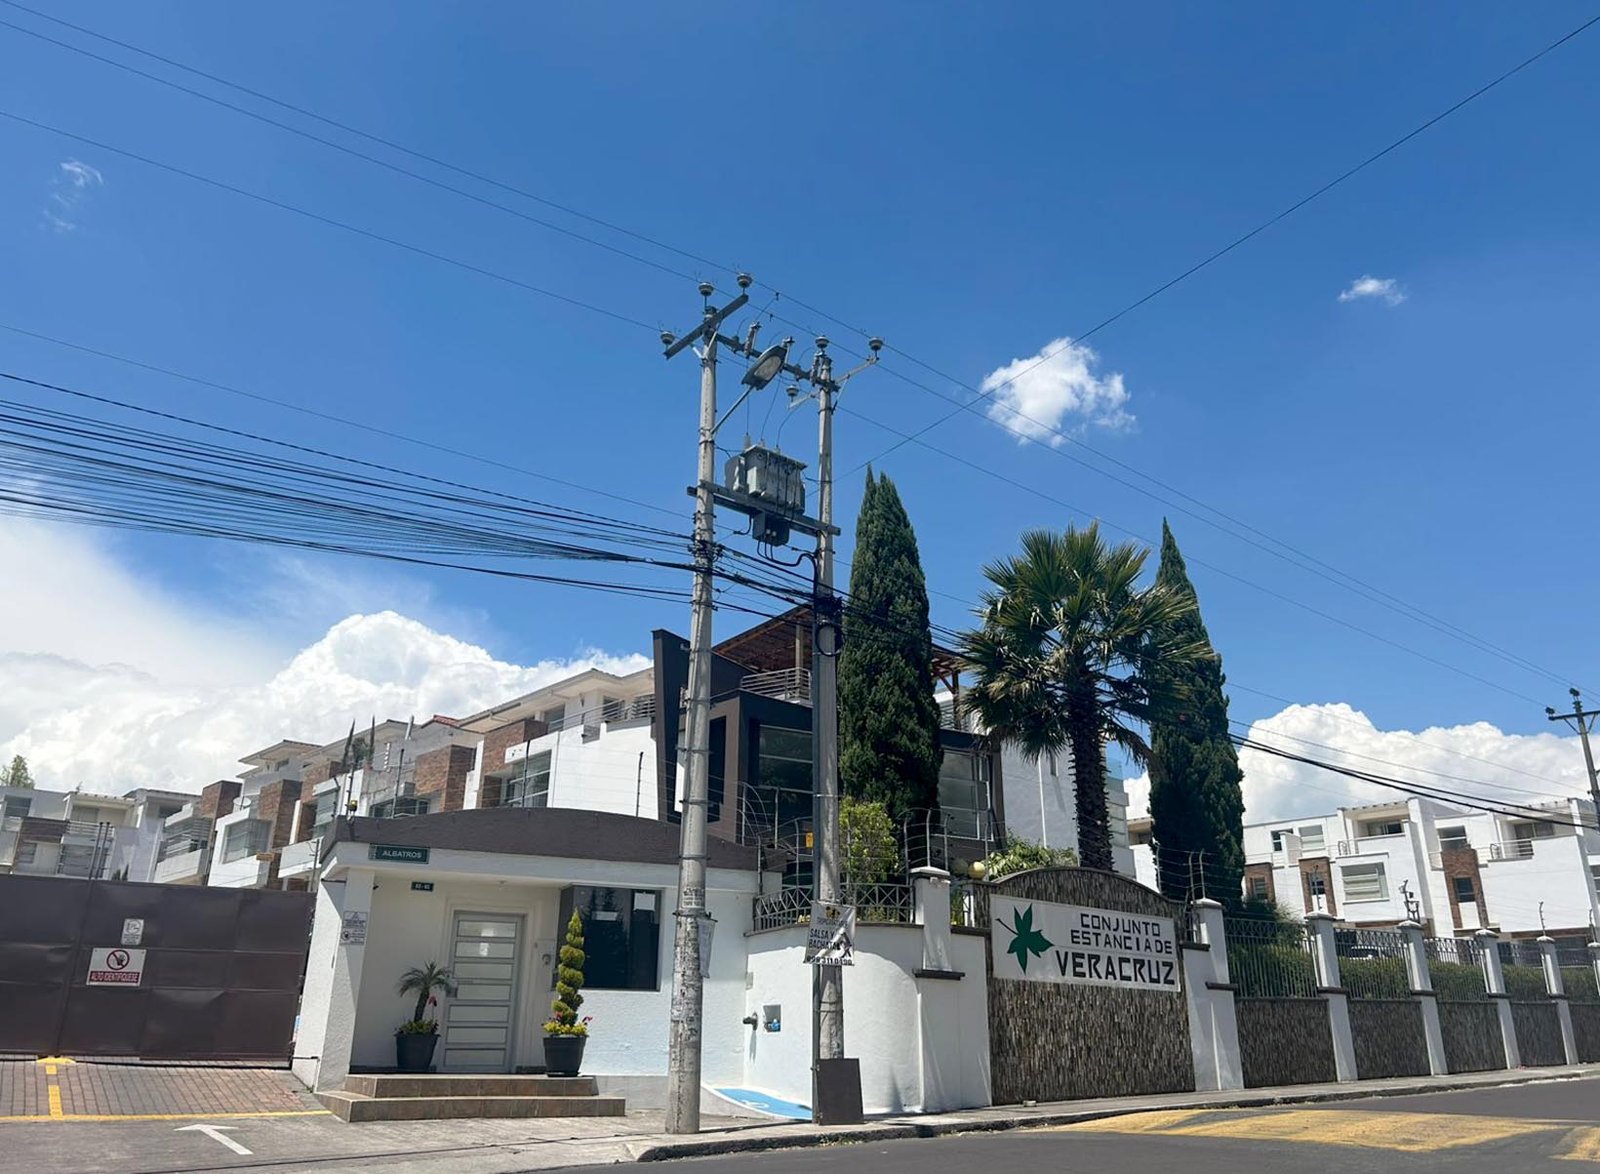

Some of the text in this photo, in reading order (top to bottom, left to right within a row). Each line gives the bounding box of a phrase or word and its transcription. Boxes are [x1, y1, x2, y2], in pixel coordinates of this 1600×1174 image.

[382, 850, 422, 859] ALBATROS
[809, 928, 828, 939] SALSA
[1080, 913, 1161, 936] CONJUNTO
[1070, 929, 1173, 954] ESTANCIA DE
[1055, 949, 1176, 986] VERACRUZ
